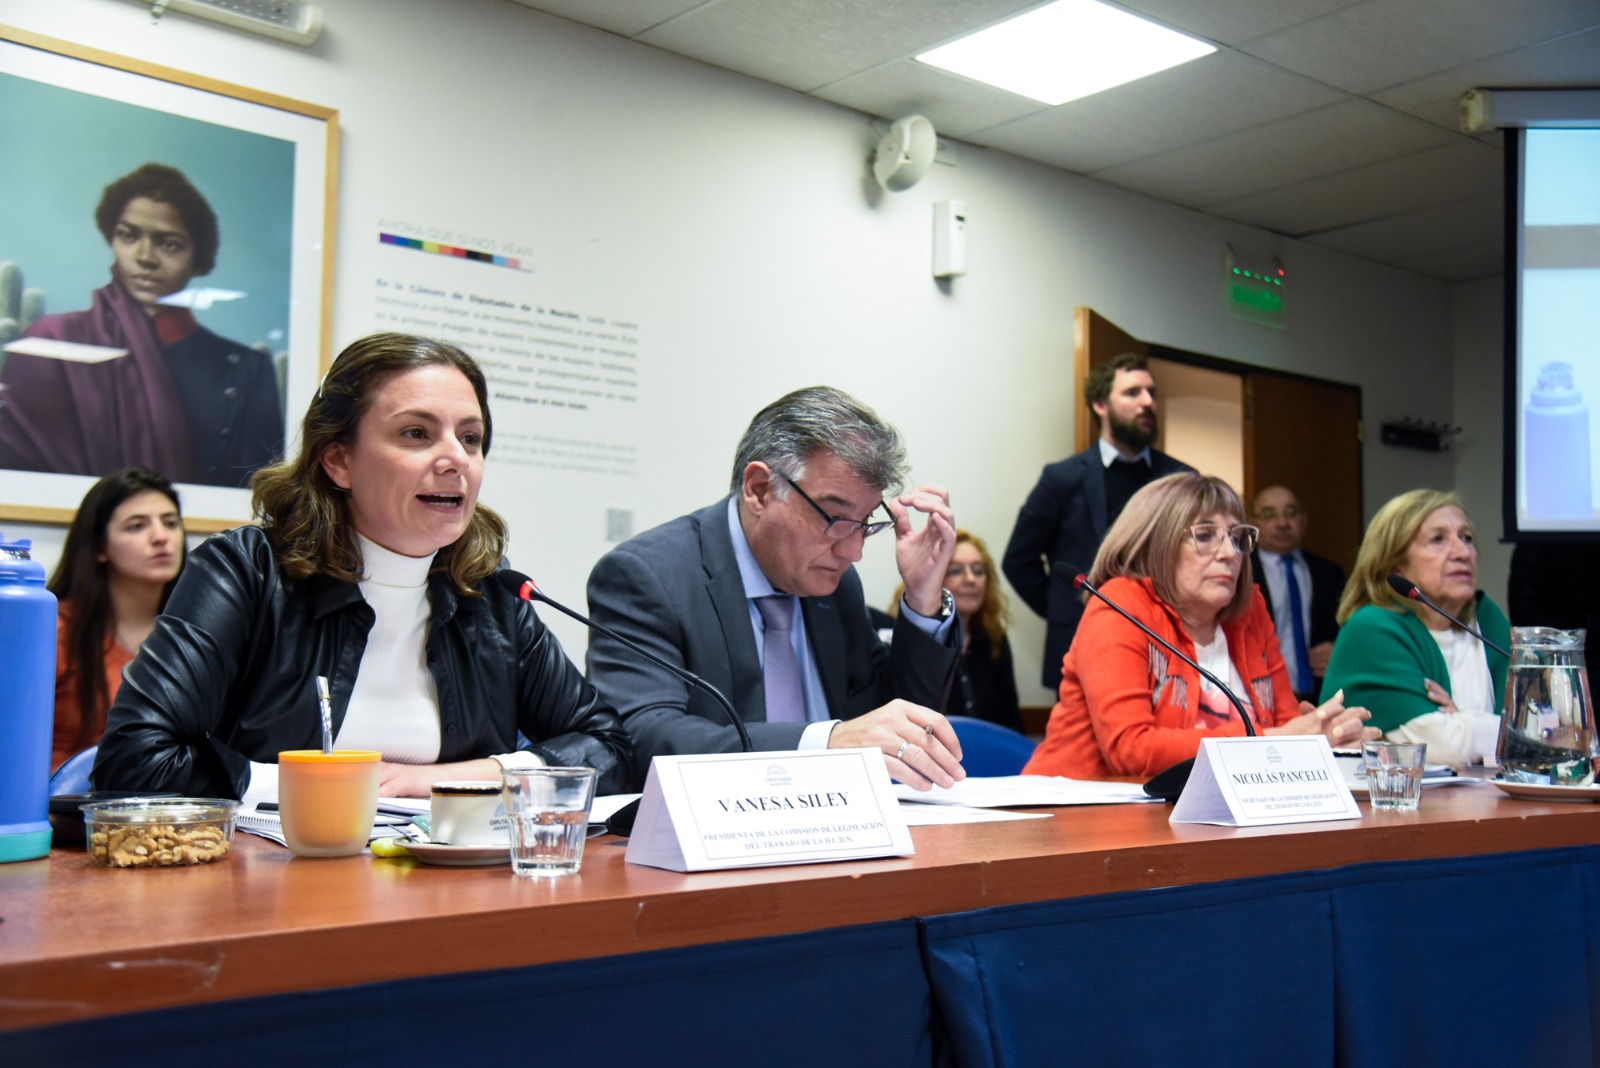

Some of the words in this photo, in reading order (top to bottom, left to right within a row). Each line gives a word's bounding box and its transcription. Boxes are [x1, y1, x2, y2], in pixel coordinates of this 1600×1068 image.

[428, 226, 453, 241] QUE
[472, 236, 497, 251] NOS
[452, 291, 463, 300] de
[469, 294, 516, 309] Diputados
[520, 304, 531, 313] de
[1232, 768, 1279, 785] NICOLÁS
[1278, 769, 1329, 783] PANCELLI
[718, 794, 795, 813] VANESA
[797, 791, 850, 809] SILEY
[703, 830, 754, 841] PRESIDENTA
[755, 830, 767, 838] DE
[768, 829, 779, 837] LA
[780, 825, 820, 837] COMISIÓN
[821, 825, 832, 834] DE
[833, 821, 884, 833] LEGISLACIÓN
[745, 841, 760, 850] DEL
[764, 838, 800, 849] TRABAJO
[801, 837, 812, 846] DE
[813, 837, 824, 845] LA
